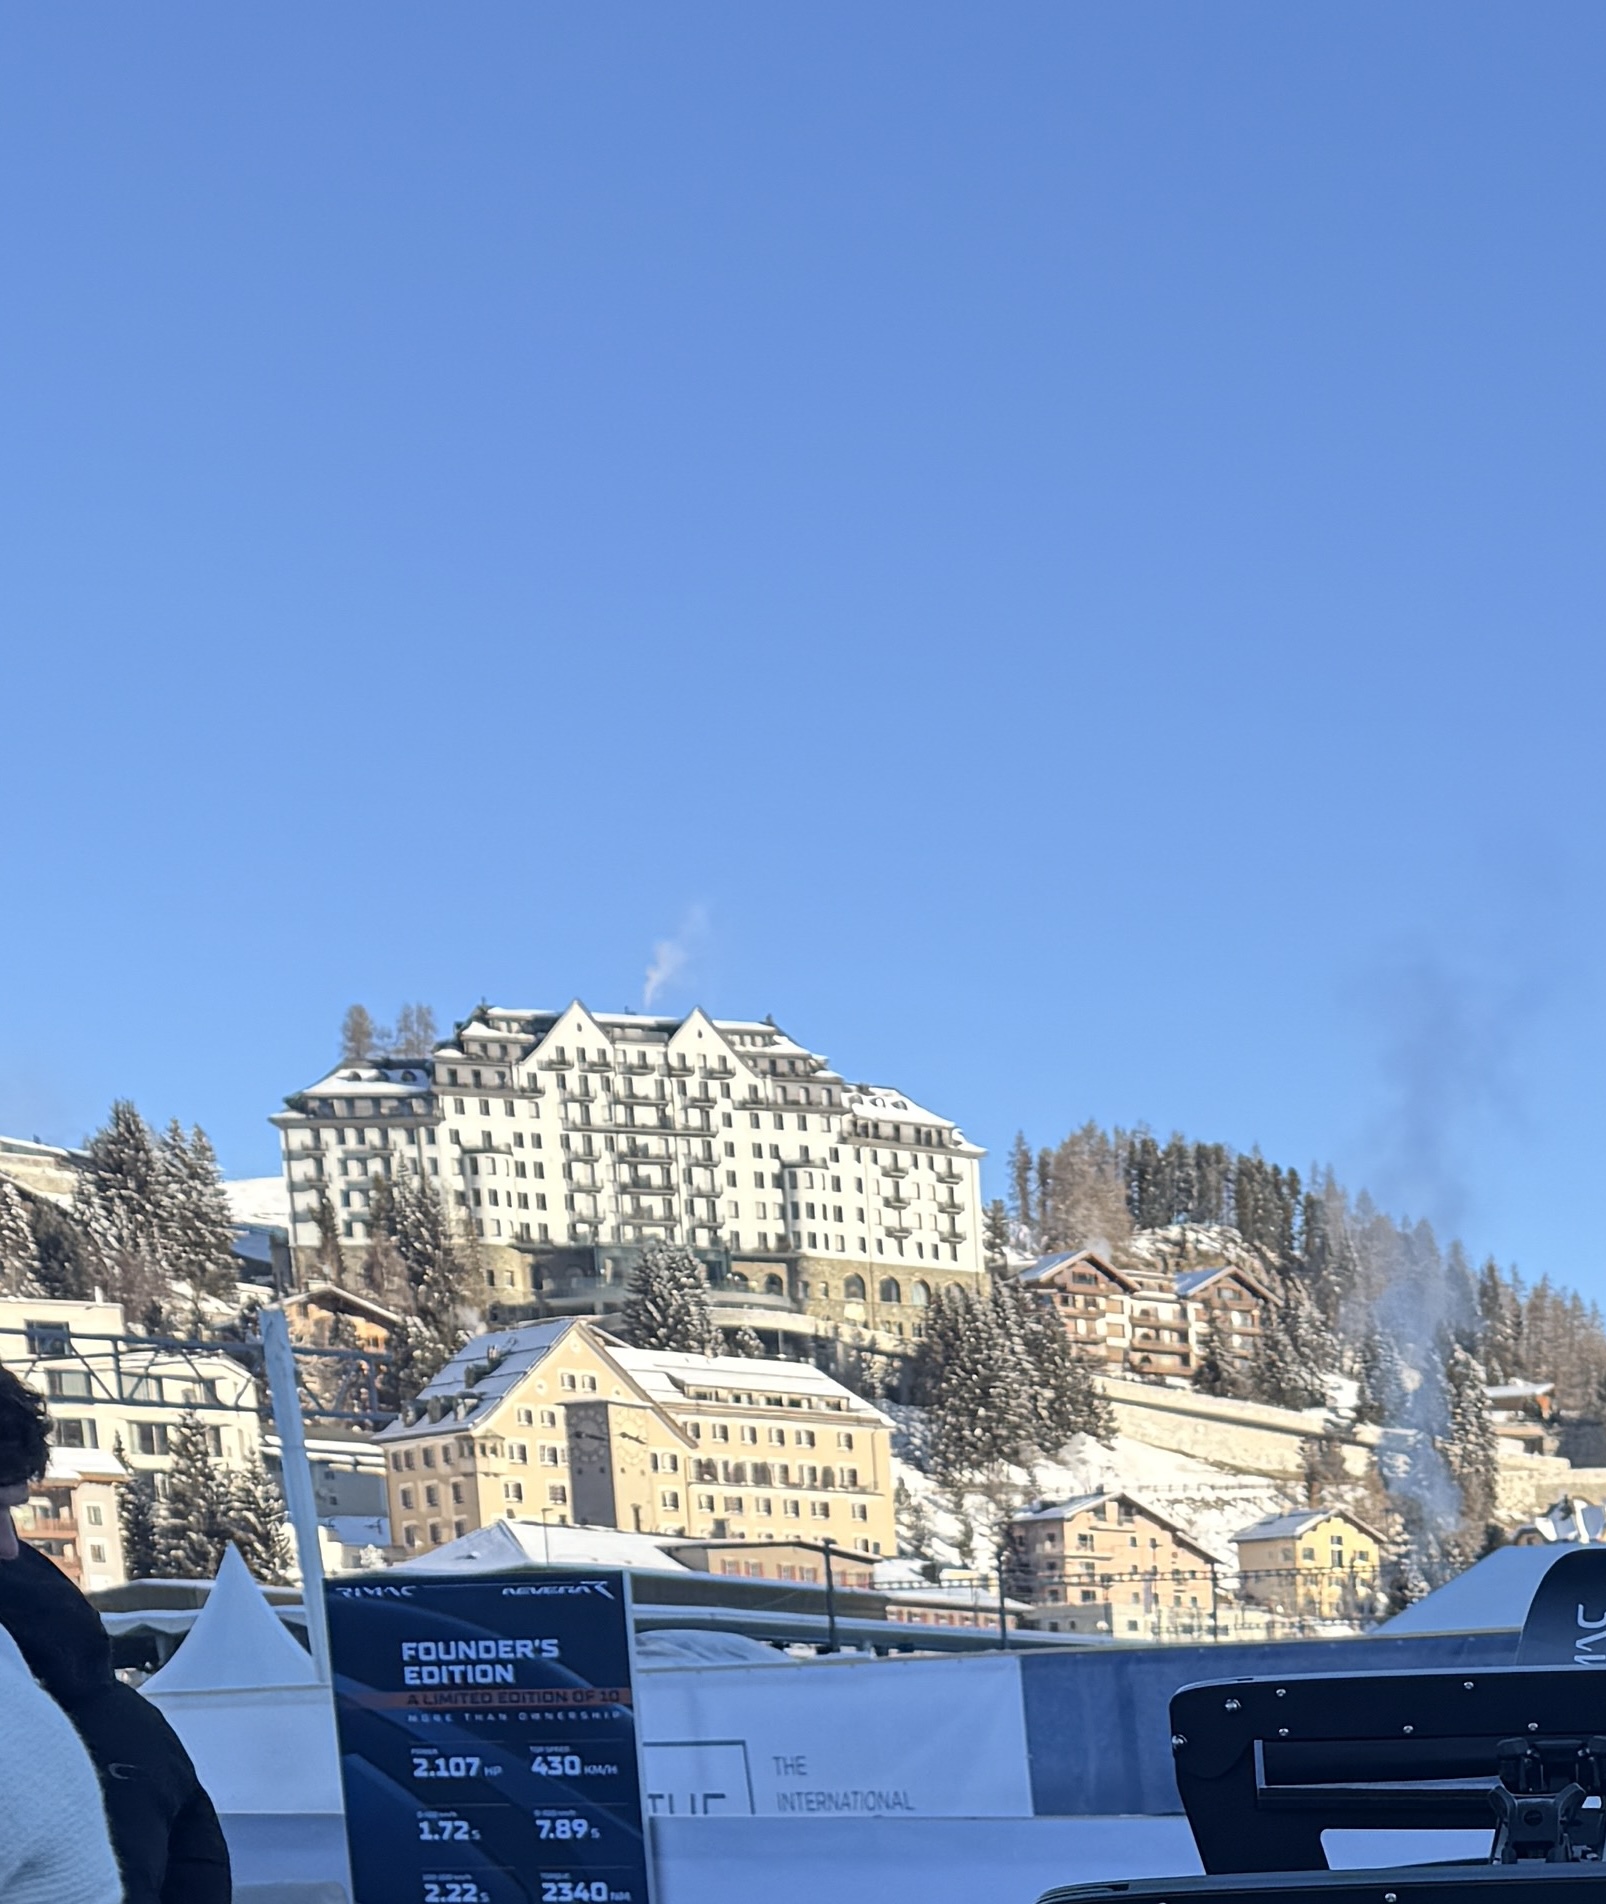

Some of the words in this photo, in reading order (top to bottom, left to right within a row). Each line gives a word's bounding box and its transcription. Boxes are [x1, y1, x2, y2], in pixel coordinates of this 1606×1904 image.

[402, 1638, 560, 1662] FOUNDER'S
[403, 1663, 515, 1686] EDITION
[406, 1694, 419, 1706] A
[422, 1692, 493, 1706] LIMITED
[498, 1690, 568, 1705] EDITION
[572, 1689, 595, 1703] OF
[600, 1688, 620, 1702] 10
[407, 1713, 453, 1723] MORE
[464, 1712, 508, 1722] THAN
[518, 1710, 621, 1721] OWNERSHIP
[412, 1757, 480, 1777] 2.107
[484, 1765, 503, 1777] HP
[530, 1755, 582, 1776] 430
[772, 1755, 808, 1777] THE
[776, 1790, 916, 1813] INTERNATIONAL
[418, 1820, 470, 1841] 1.72
[535, 1818, 589, 1840] 7.89
[424, 1882, 478, 1903] 2.22
[541, 1881, 609, 1902] 2340
